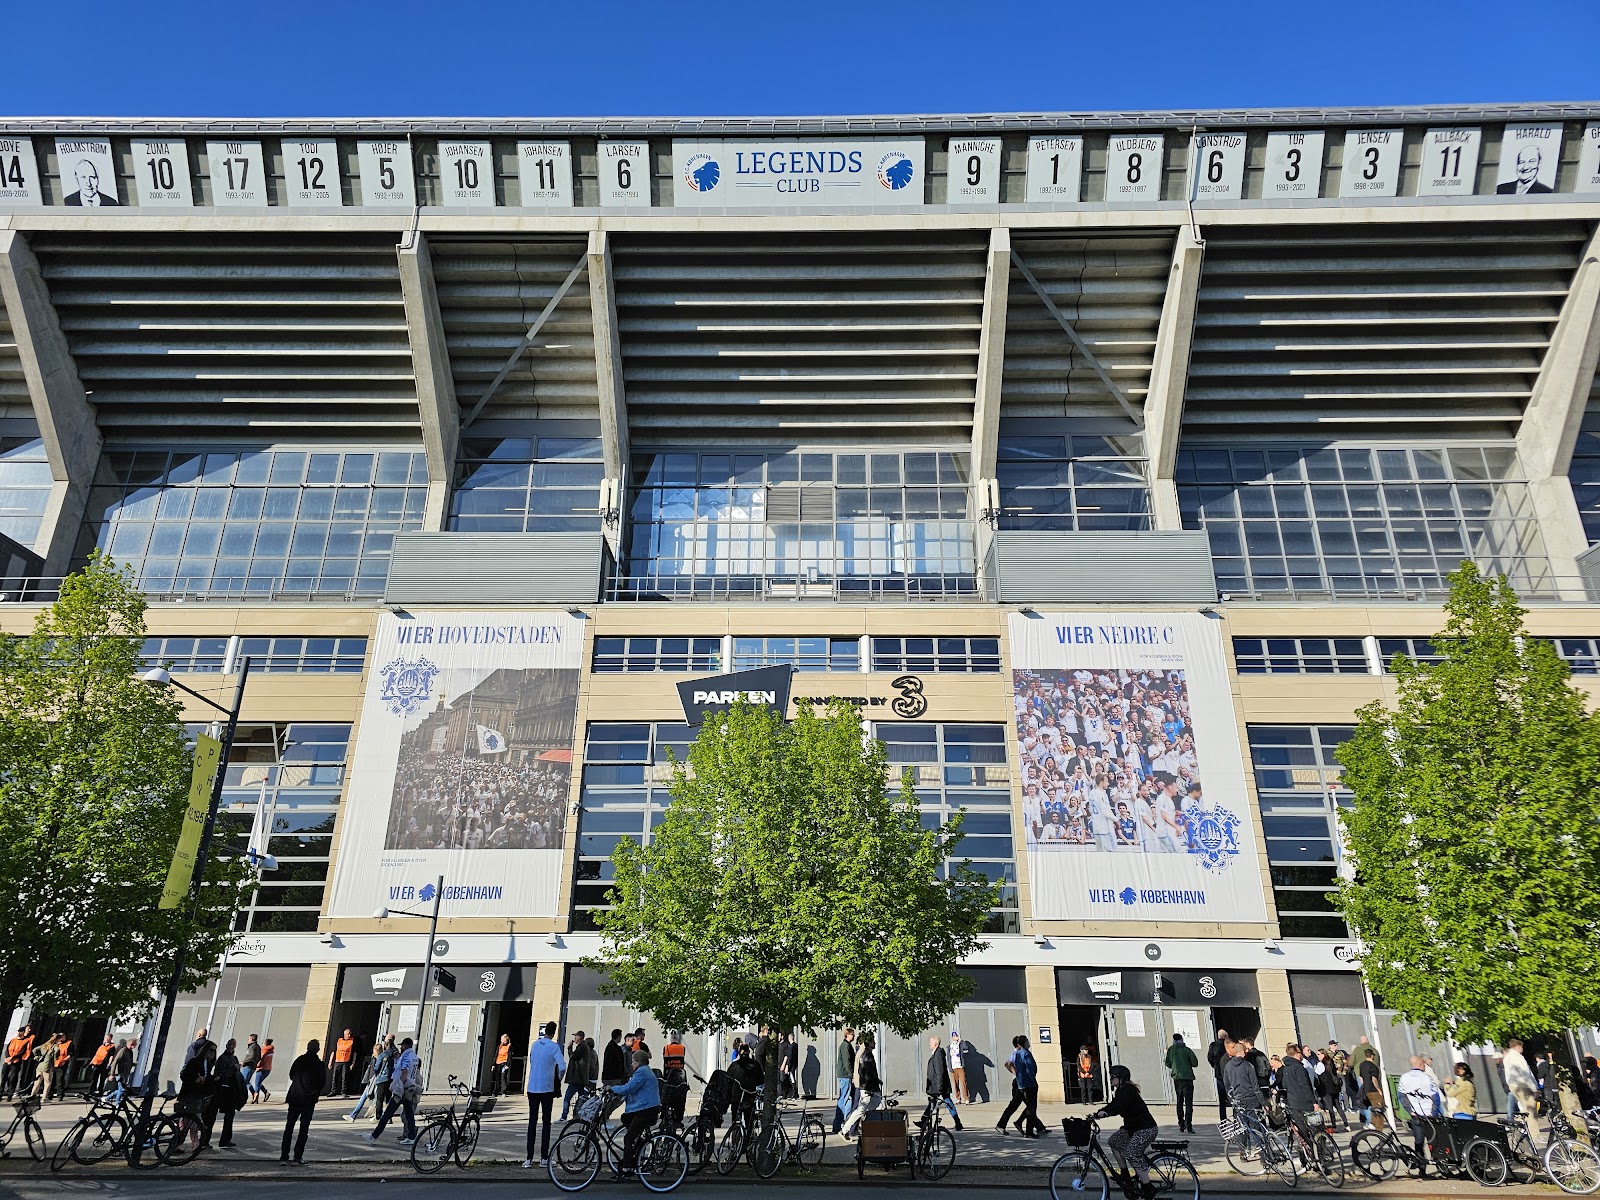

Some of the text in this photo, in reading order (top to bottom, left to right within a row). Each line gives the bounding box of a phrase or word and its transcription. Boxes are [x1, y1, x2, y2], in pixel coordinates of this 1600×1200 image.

[1288, 133, 1305, 145] TUR
[1357, 132, 1391, 145] JENSEN
[1516, 128, 1552, 140] HARALD
[59, 142, 107, 154] HOLMSTRØM
[146, 143, 170, 155] ZUMA
[226, 143, 242, 155] MIO
[299, 143, 318, 154] TODI
[371, 143, 398, 155] HØJER
[445, 145, 484, 158] JOHANSEN
[523, 145, 563, 158] JOHANSEN
[606, 145, 641, 158] LARSEN
[954, 141, 996, 154] MANNICHE
[1035, 139, 1076, 152] PETERSEN
[1116, 138, 1158, 152] ULDBJERG
[735, 151, 863, 174] LEGENDS
[1127, 152, 1142, 184] 8
[1207, 150, 1224, 183] 6
[1285, 148, 1300, 181] 3
[1363, 147, 1379, 180] 3
[1441, 146, 1463, 177] 11
[147, 157, 174, 190] 10
[223, 157, 249, 190] 17
[297, 157, 326, 190] 12
[379, 157, 395, 190] 5
[454, 159, 479, 189] 10
[535, 159, 555, 189] 11
[617, 158, 631, 189] 6
[966, 155, 981, 186] 9
[1050, 153, 1059, 185] 1
[777, 179, 820, 193] CLUB
[398, 625, 564, 644] VI ER HOVEDSTADEN
[1056, 626, 1174, 644] VI ER NEDRE C
[870, 697, 888, 706] BY
[196, 755, 203, 768] C
[390, 886, 503, 900] VI ER KØBENHAVN
[1089, 889, 1206, 904] VI ER KØBENHAVN
